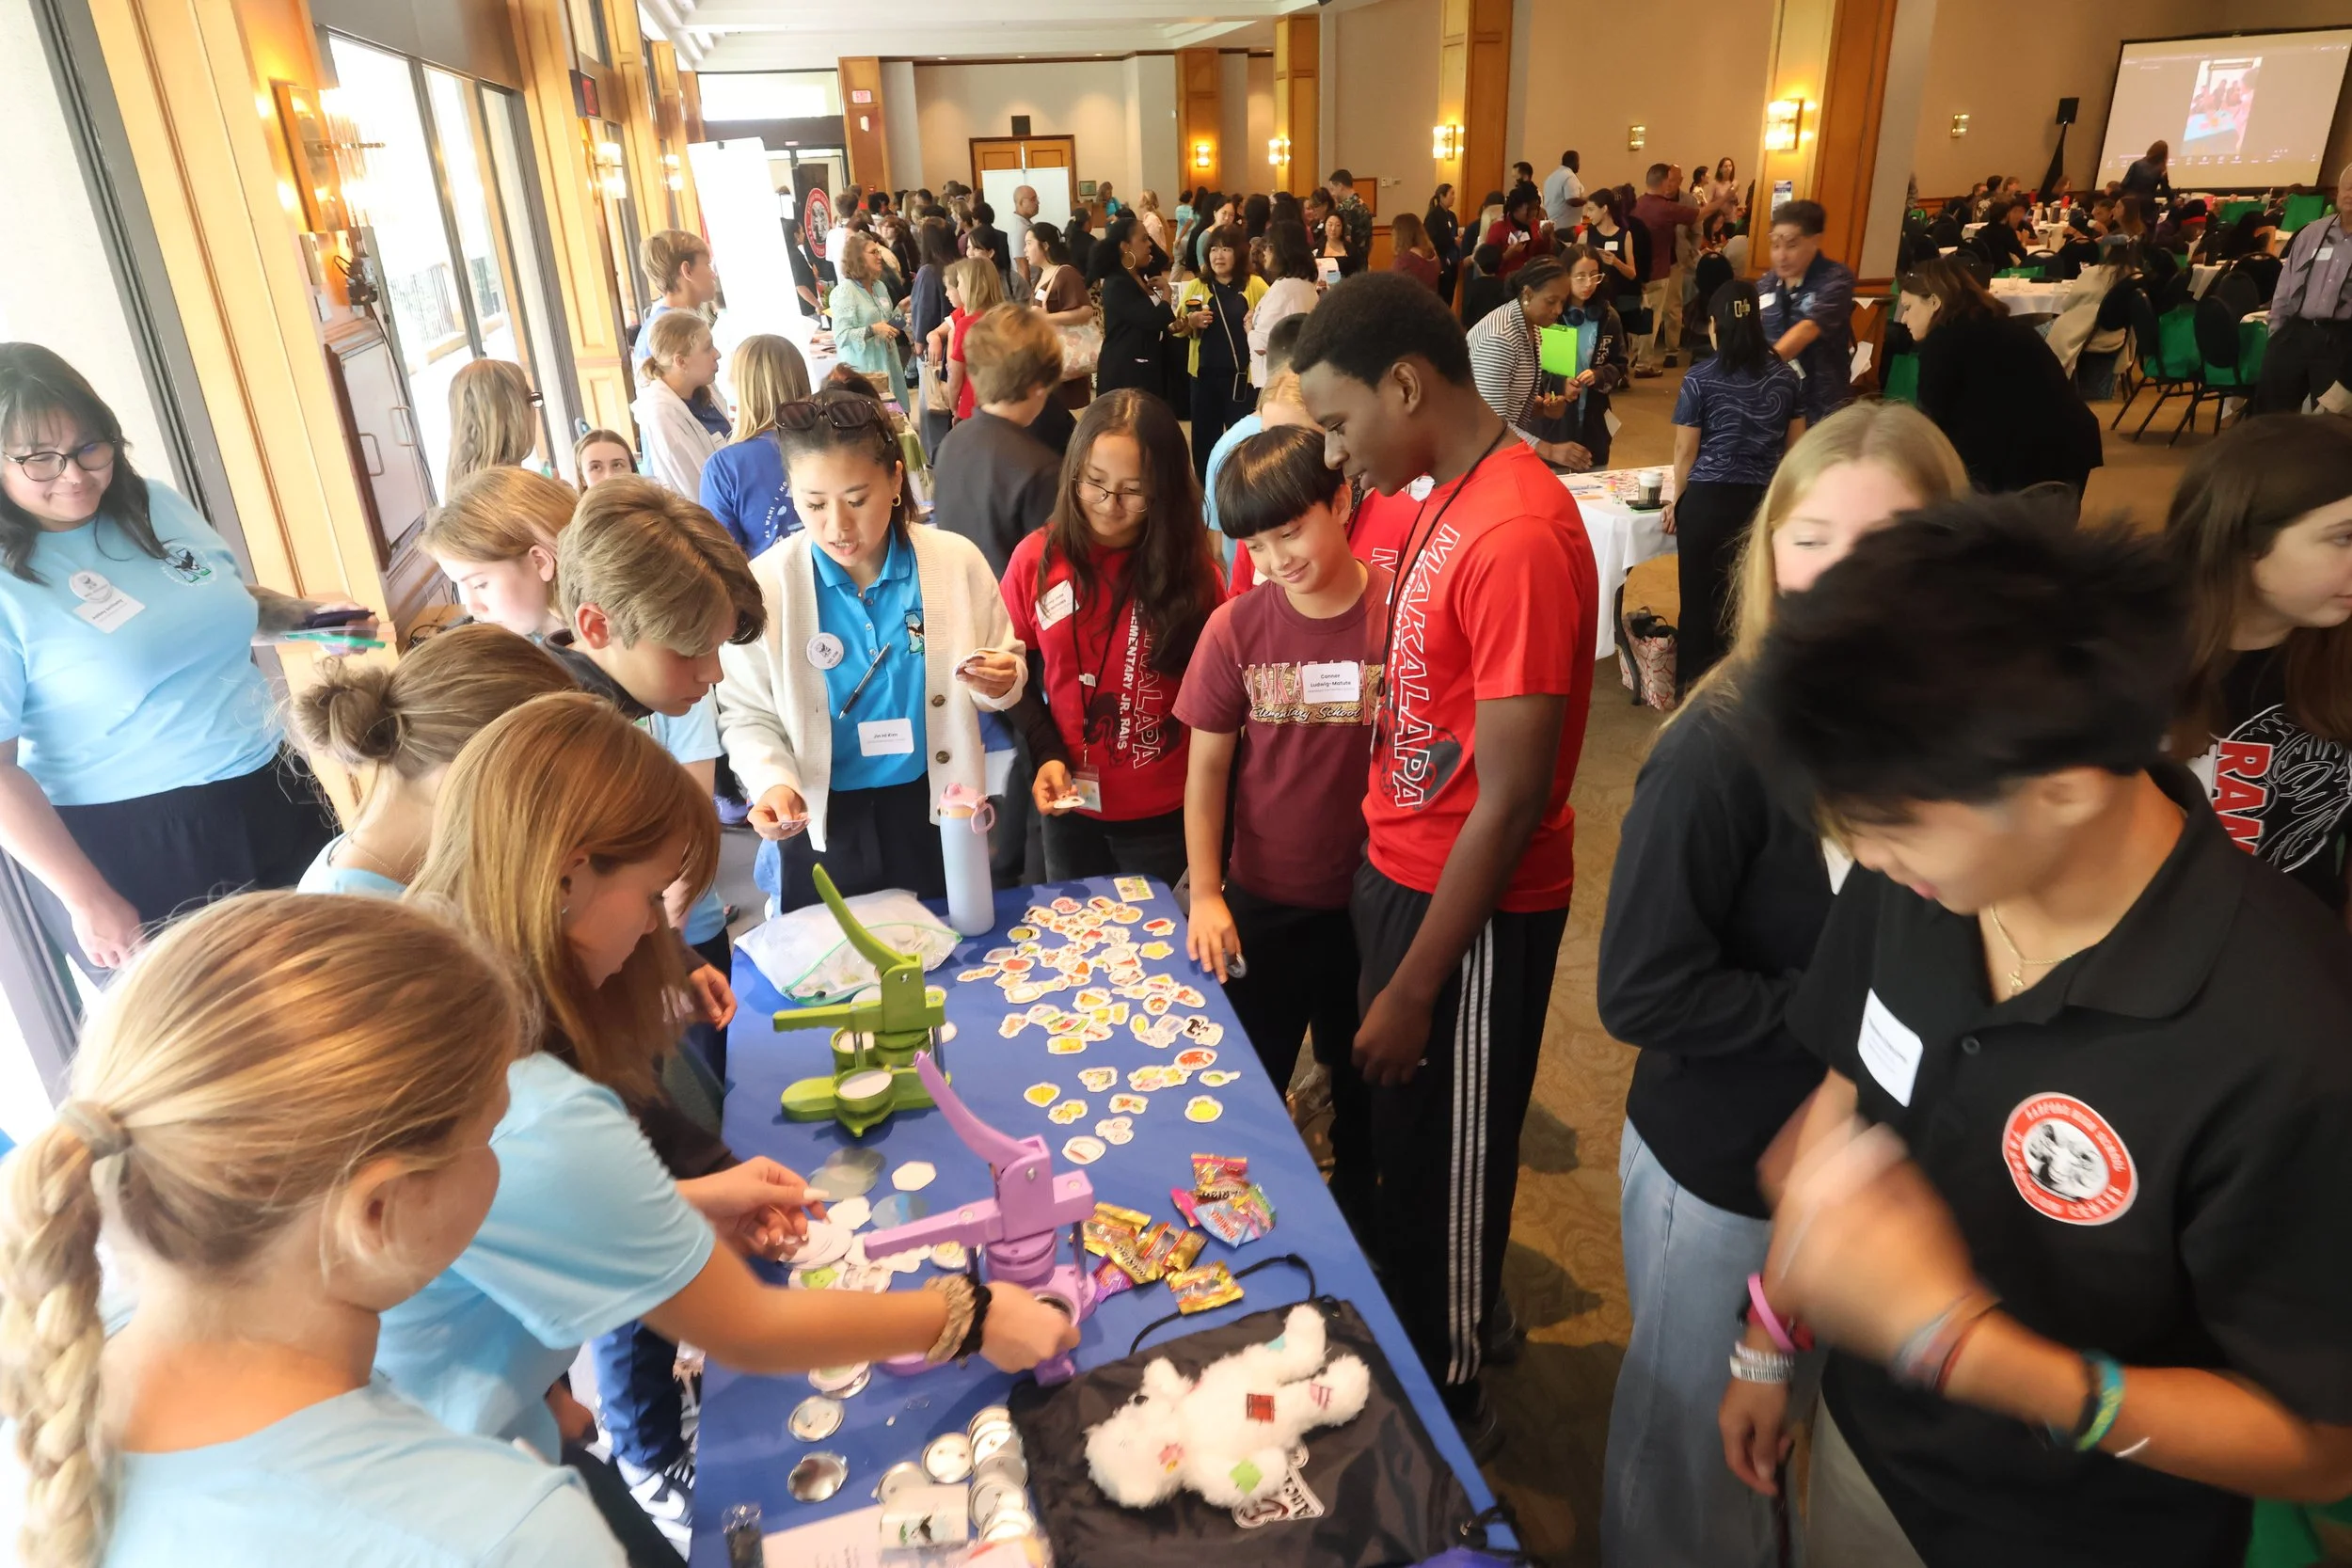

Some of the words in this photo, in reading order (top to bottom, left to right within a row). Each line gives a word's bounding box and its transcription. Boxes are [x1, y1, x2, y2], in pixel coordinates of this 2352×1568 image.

[1122, 600, 1142, 689] LEMENTARY
[1392, 523, 1460, 807] MAKALAPA
[1132, 627, 1162, 768] ALAPA
[1238, 659, 1372, 726] MAKAA
[1316, 706, 1361, 719] School
